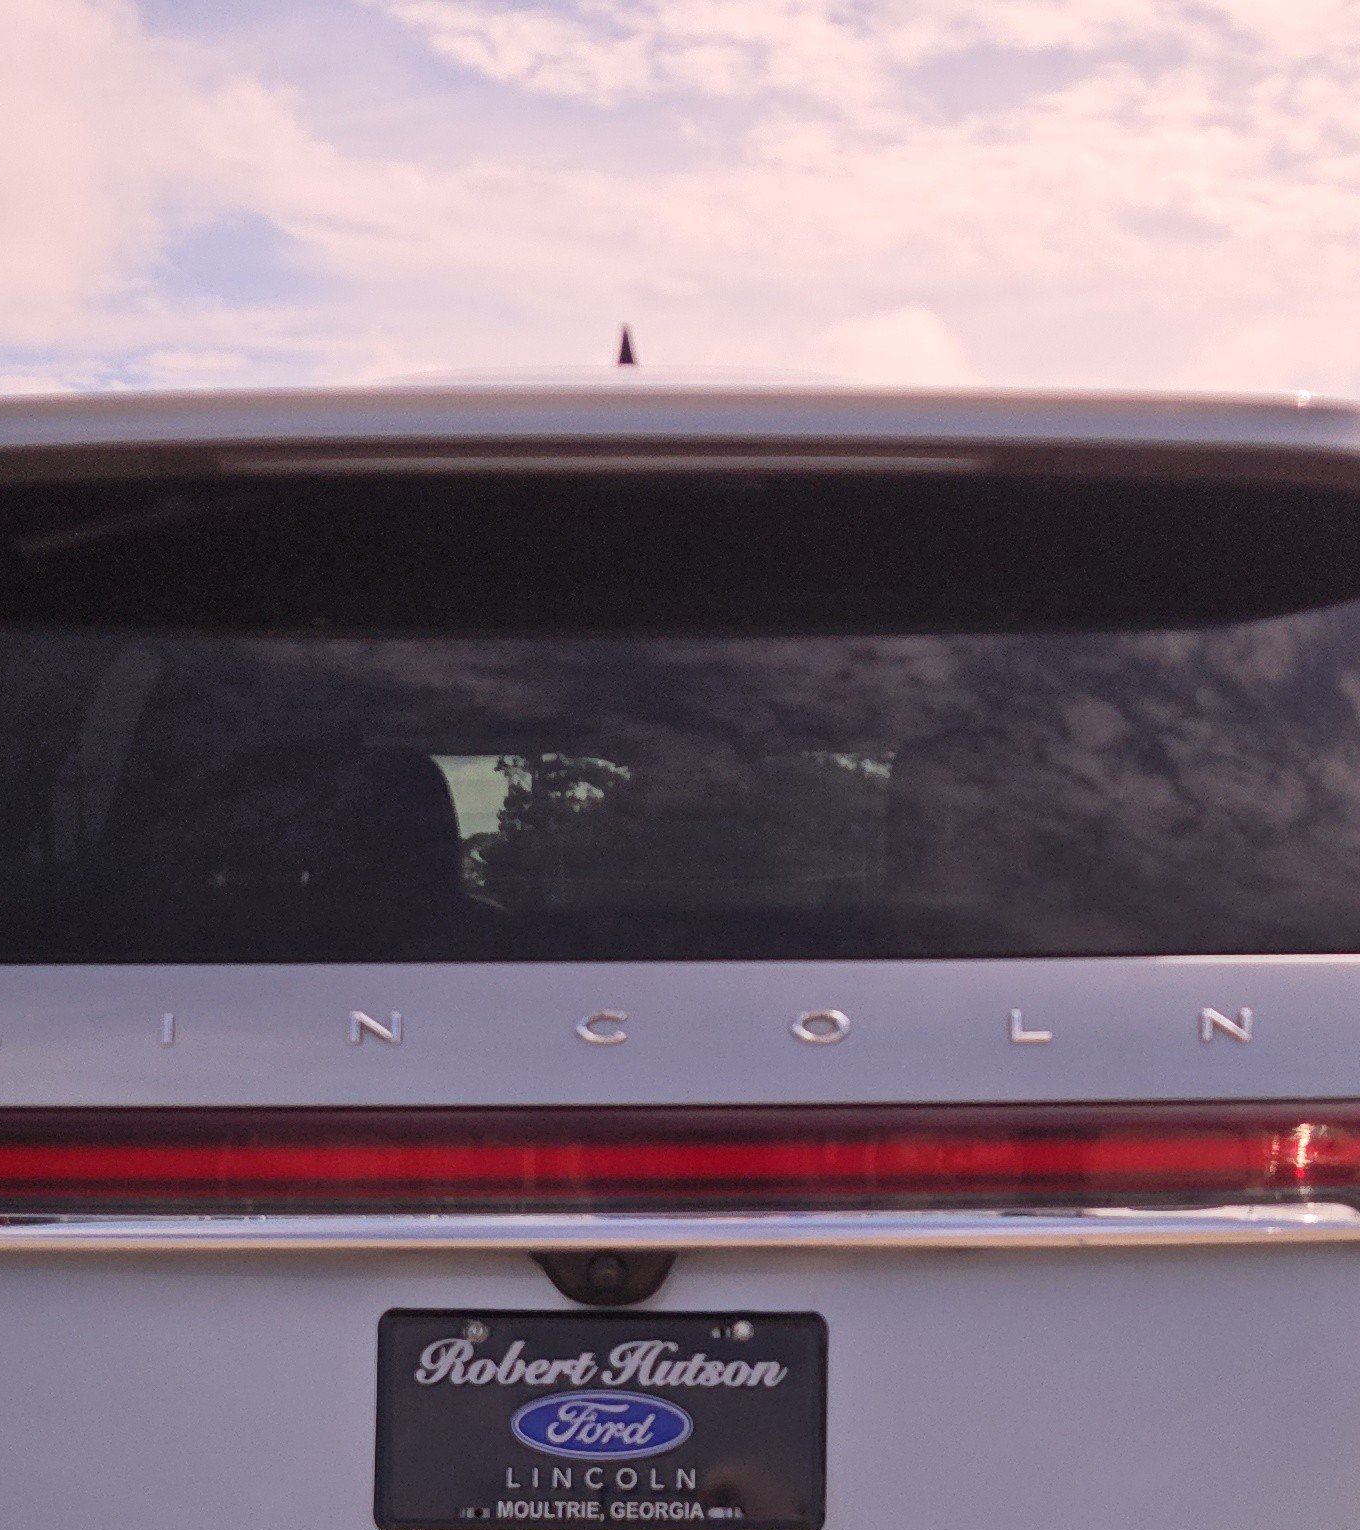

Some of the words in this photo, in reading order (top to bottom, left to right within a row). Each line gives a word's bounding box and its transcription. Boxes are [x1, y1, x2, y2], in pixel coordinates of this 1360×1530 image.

[414, 1338, 599, 1386] Robert
[600, 1339, 788, 1388] Hutson
[546, 1401, 656, 1445] Ford
[505, 1466, 697, 1490] LINCOLN
[496, 1500, 605, 1522] MOULTRIE,
[610, 1500, 705, 1520] GEORGIA
